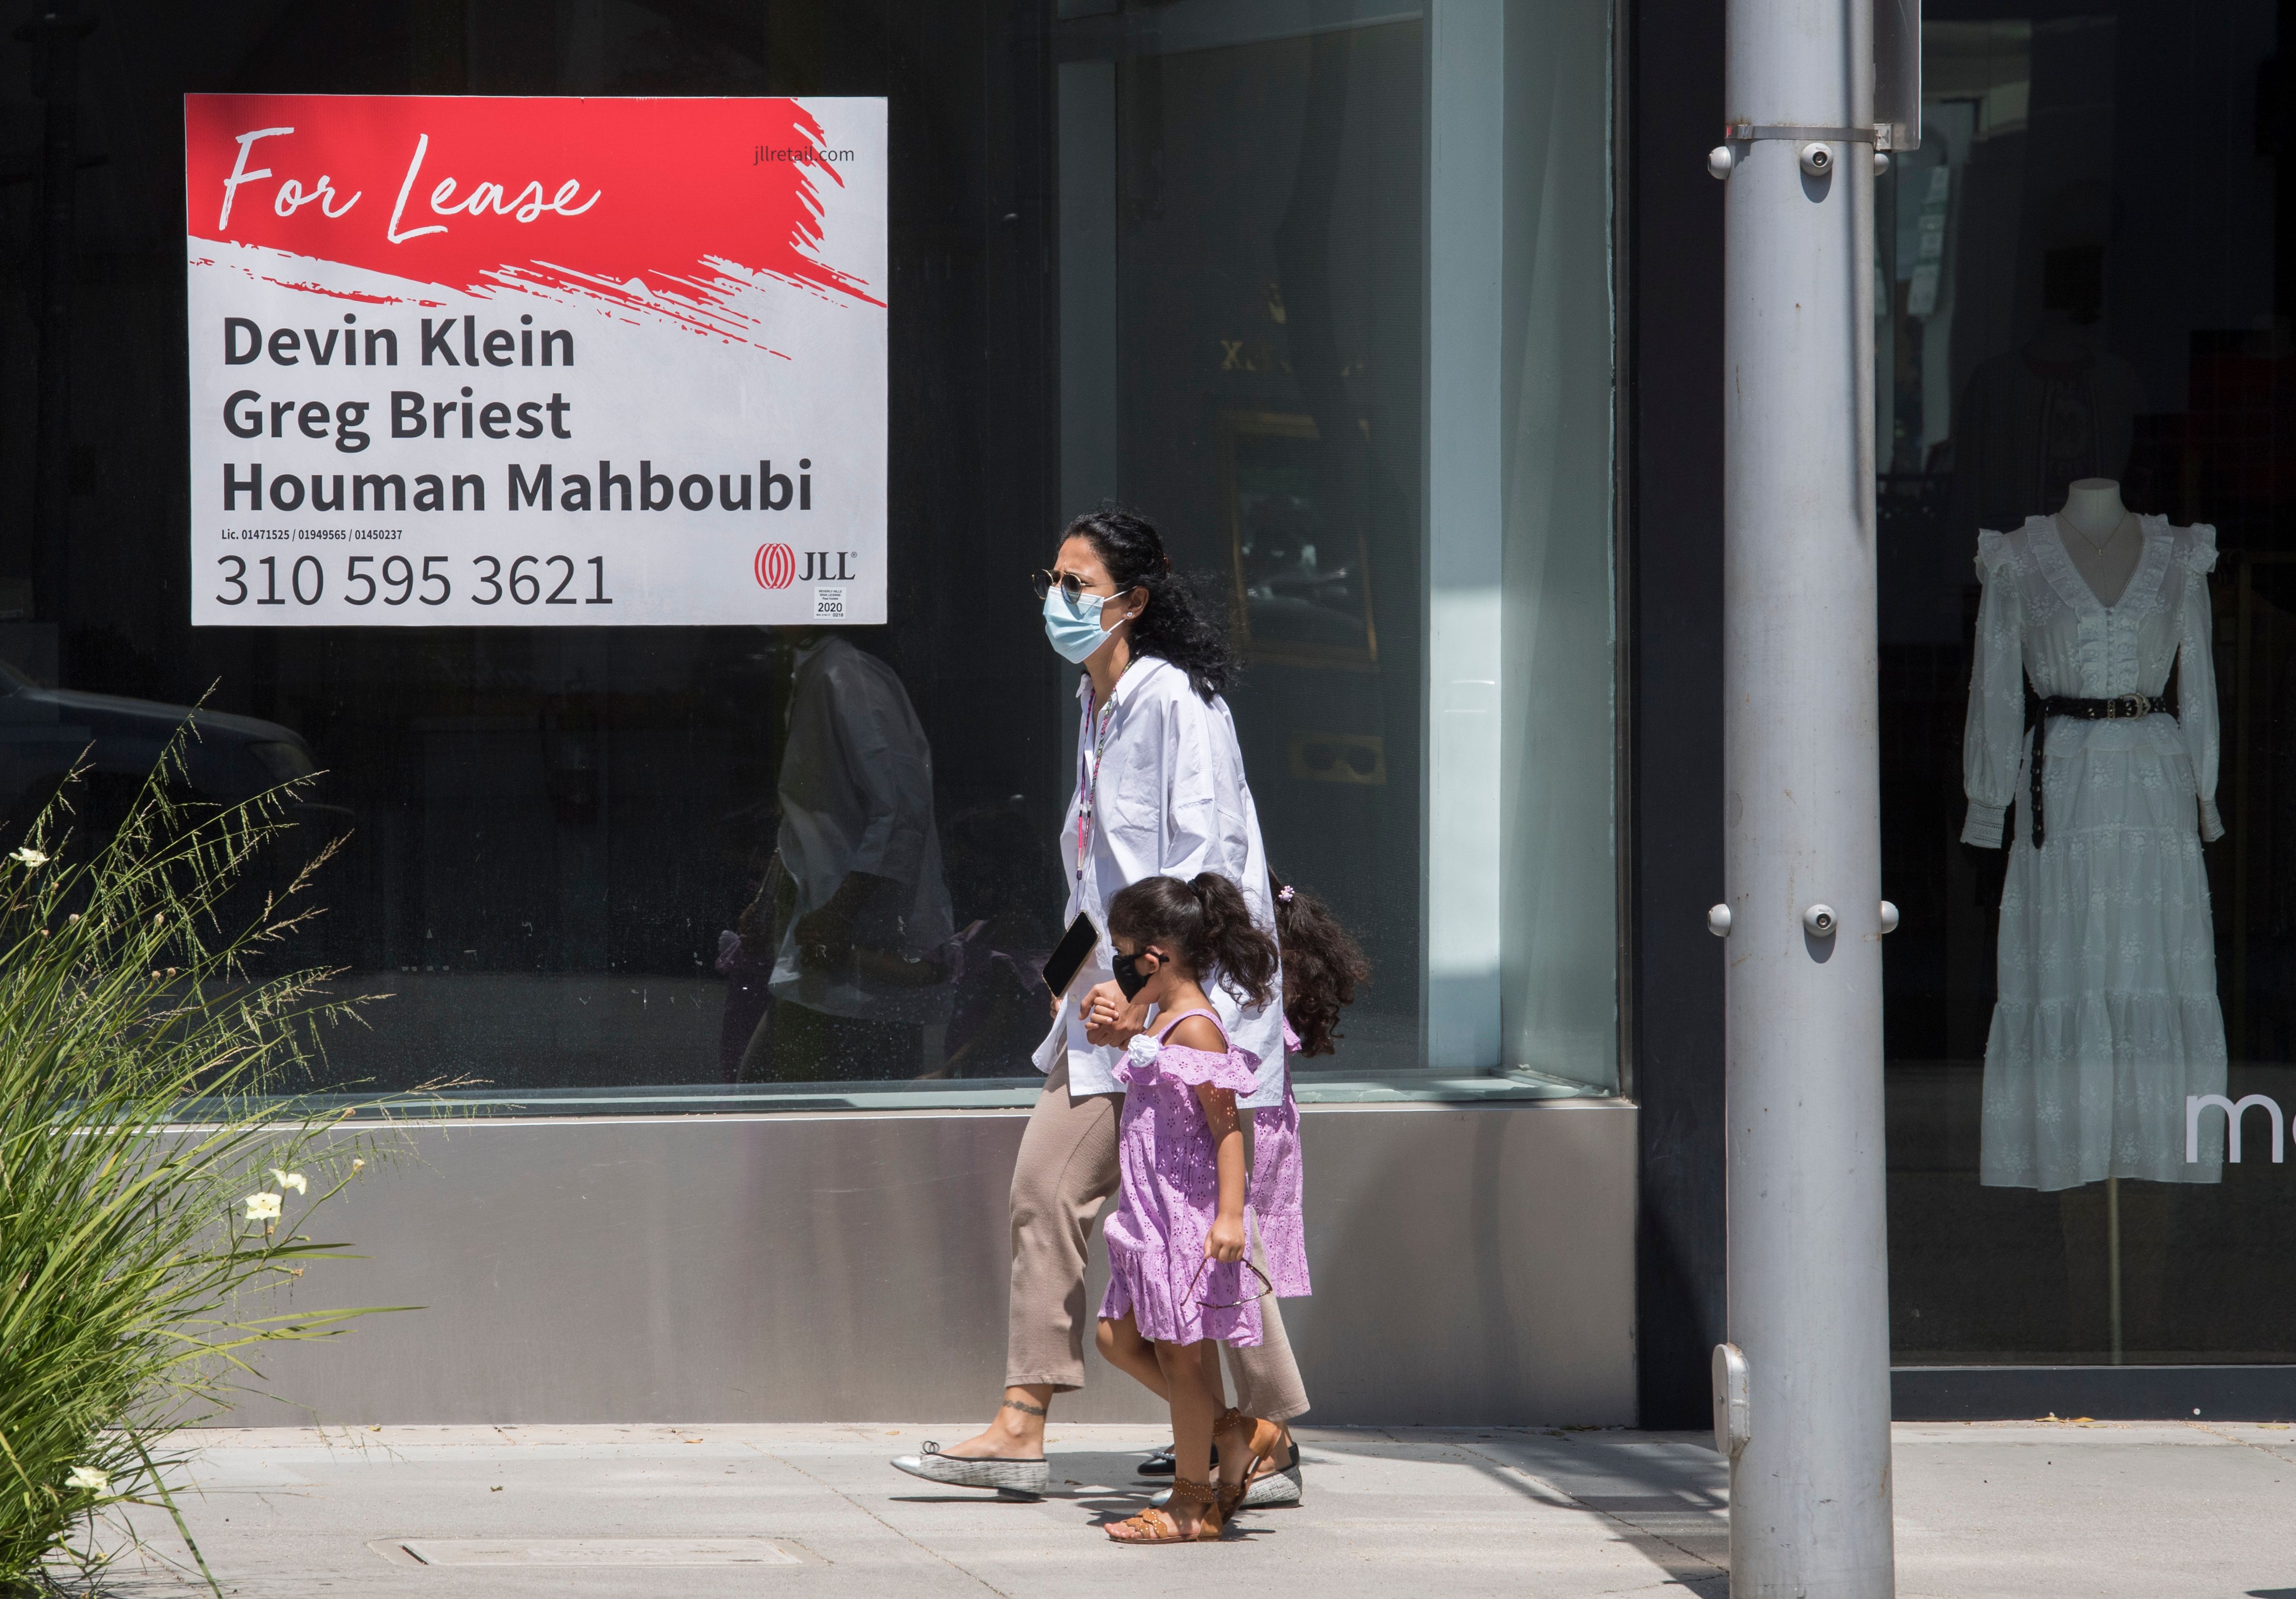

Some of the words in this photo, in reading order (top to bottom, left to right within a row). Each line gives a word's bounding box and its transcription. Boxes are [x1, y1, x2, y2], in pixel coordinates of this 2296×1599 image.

[753, 145, 854, 166] jllretail.com
[219, 128, 361, 231] For
[387, 134, 601, 244] Lease
[225, 313, 397, 366] Devin
[420, 314, 574, 366] Klein
[223, 390, 370, 453] Greg
[391, 386, 572, 439] Briest
[224, 463, 485, 512] Houman
[508, 458, 811, 512] Mahboubi
[222, 528, 239, 540] Lic.
[241, 529, 290, 540] 01471525
[298, 529, 347, 540] 01949565
[355, 529, 402, 540] 01450237
[215, 555, 324, 606] 310
[343, 555, 451, 606] 595
[471, 555, 613, 605] 3621
[818, 602, 842, 612] 2020
